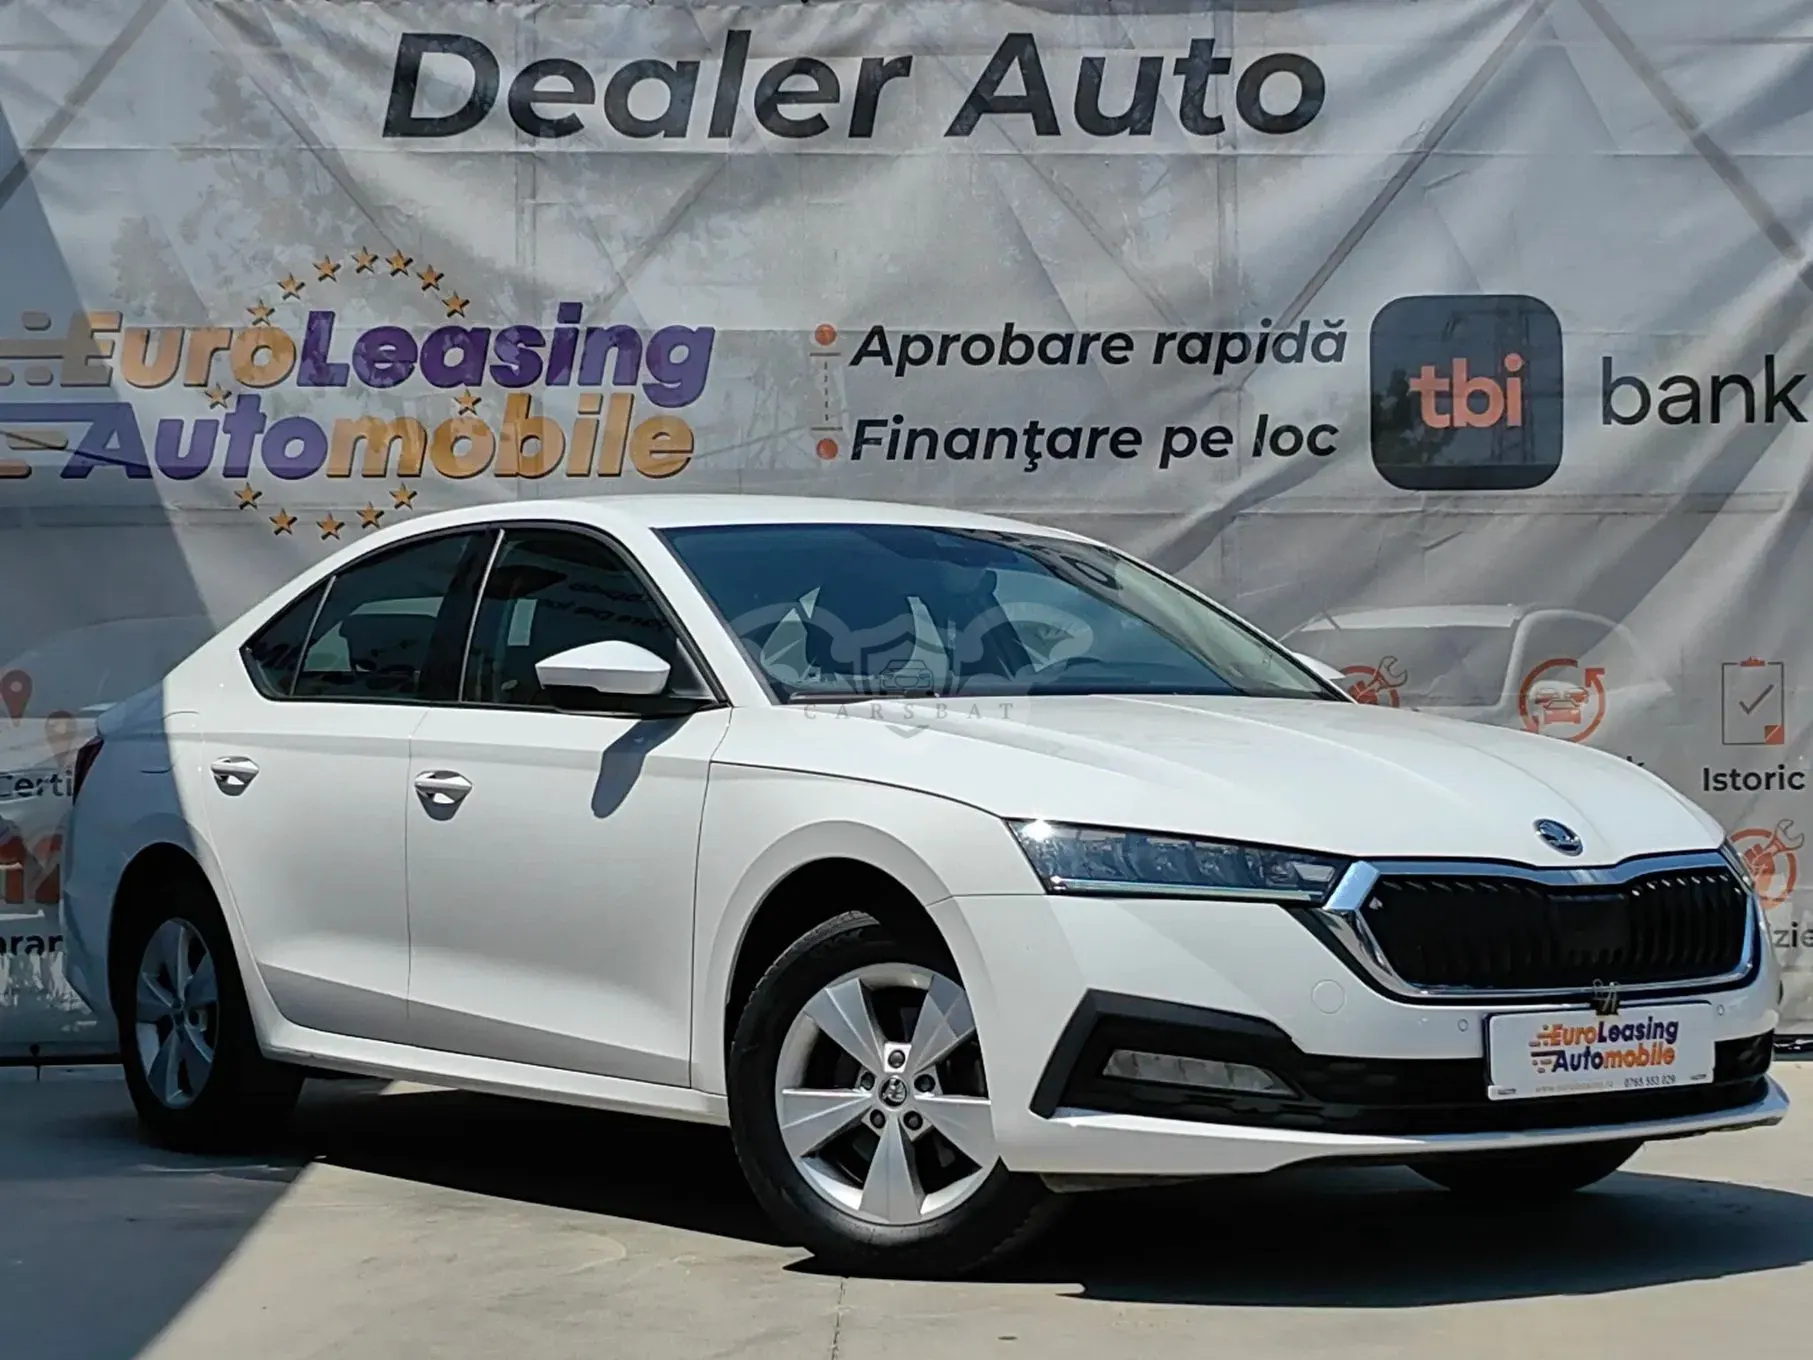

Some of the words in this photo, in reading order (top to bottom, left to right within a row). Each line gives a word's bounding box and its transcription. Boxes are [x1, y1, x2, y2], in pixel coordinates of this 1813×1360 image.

[382, 30, 912, 138] Dealer
[944, 33, 1326, 136] Auto
[60, 302, 714, 407] EuroLeasing
[849, 322, 1134, 377] Aprobare
[1152, 318, 1347, 375] rapidă
[1409, 353, 1524, 429] tbi
[1602, 354, 1808, 425] bank
[60, 393, 694, 480] Automobile
[851, 414, 1142, 472] Finanţare
[1159, 424, 1234, 469] pe
[1252, 414, 1339, 458] loc
[1703, 764, 1805, 791] Istoric
[1551, 1016, 1679, 1044] EuroLeasing
[1551, 1042, 1676, 1072] Automobile
